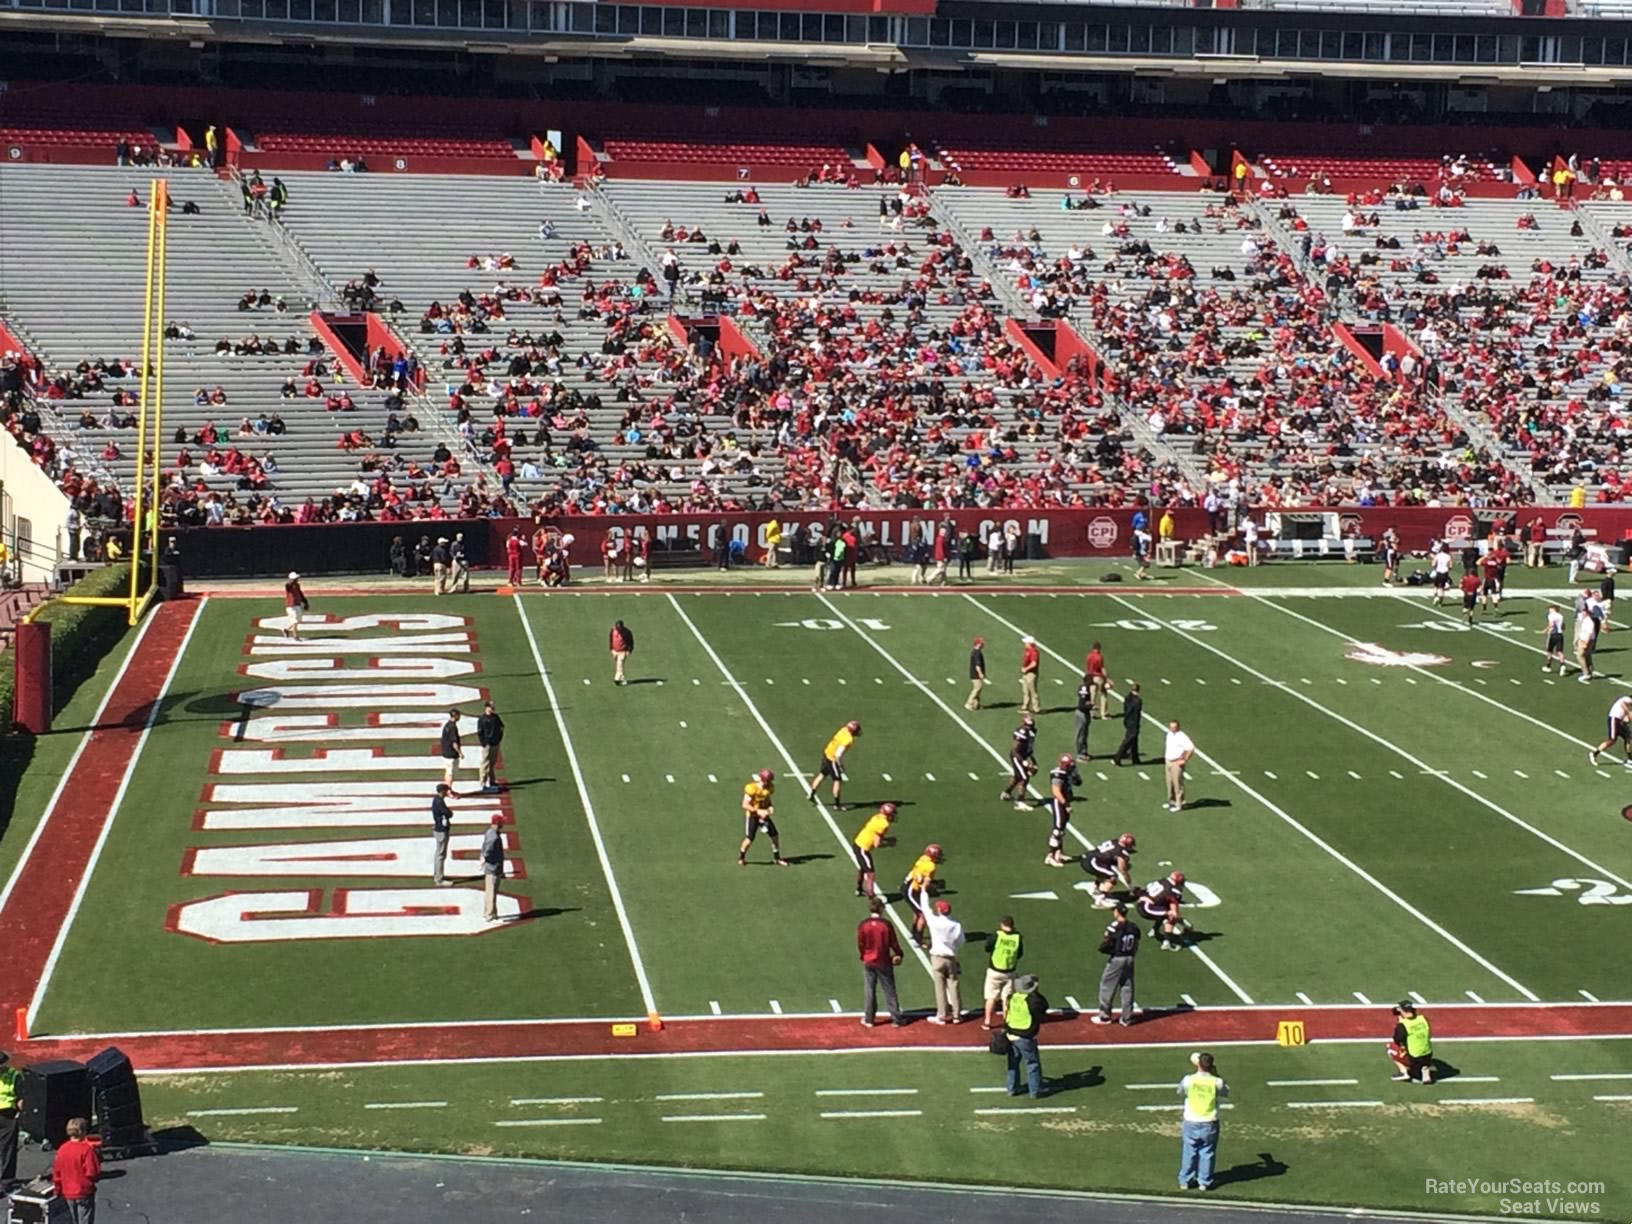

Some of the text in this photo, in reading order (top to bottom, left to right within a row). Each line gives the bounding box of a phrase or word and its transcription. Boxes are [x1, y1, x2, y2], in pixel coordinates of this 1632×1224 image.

[10, 148, 20, 158] 9
[395, 160, 405, 170] 8
[739, 169, 748, 179] 7
[1070, 176, 1079, 186] 6
[1090, 527, 1114, 537] CPI
[800, 618, 892, 631] 10
[166, 613, 531, 943] GAMECOCKS
[1122, 934, 1135, 952] 10
[1283, 1024, 1302, 1046] 10
